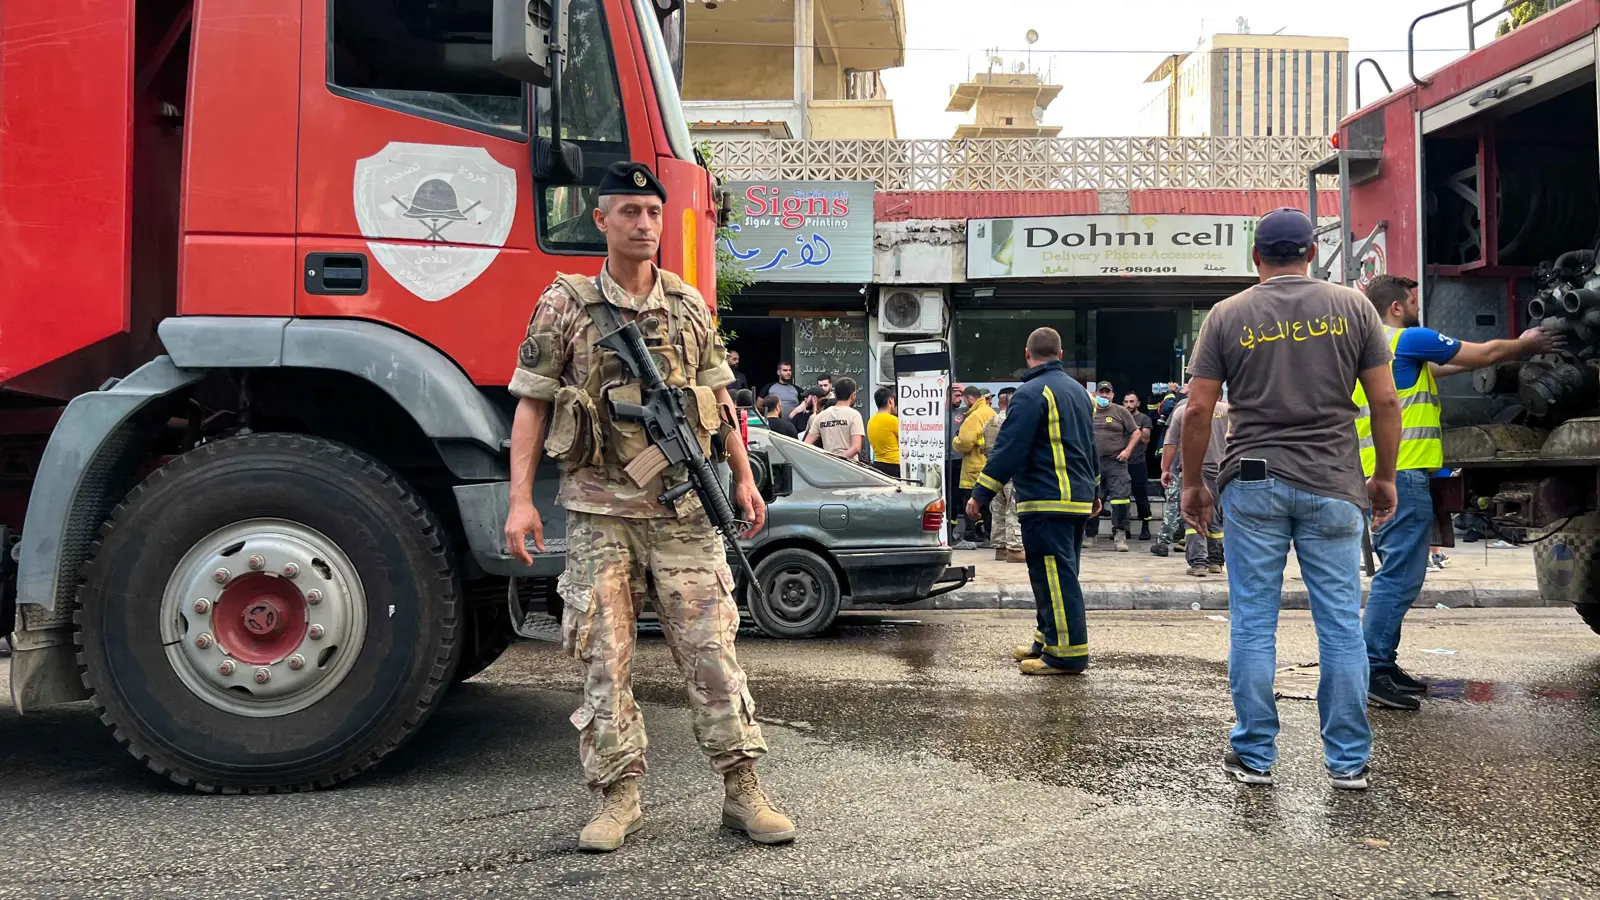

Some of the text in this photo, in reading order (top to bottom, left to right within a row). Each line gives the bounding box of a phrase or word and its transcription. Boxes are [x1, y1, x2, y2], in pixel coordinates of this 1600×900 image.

[744, 185, 849, 229] Signs
[745, 217, 770, 229] Signs
[805, 217, 848, 229] Printing
[1023, 223, 1234, 248] Dohni cell
[1042, 249, 1224, 263] Delivery Phone Accessories
[1100, 265, 1177, 274] 78-980401
[1204, 263, 1227, 273] جملة
[900, 384, 943, 399] Dohni
[902, 401, 940, 416] cell
